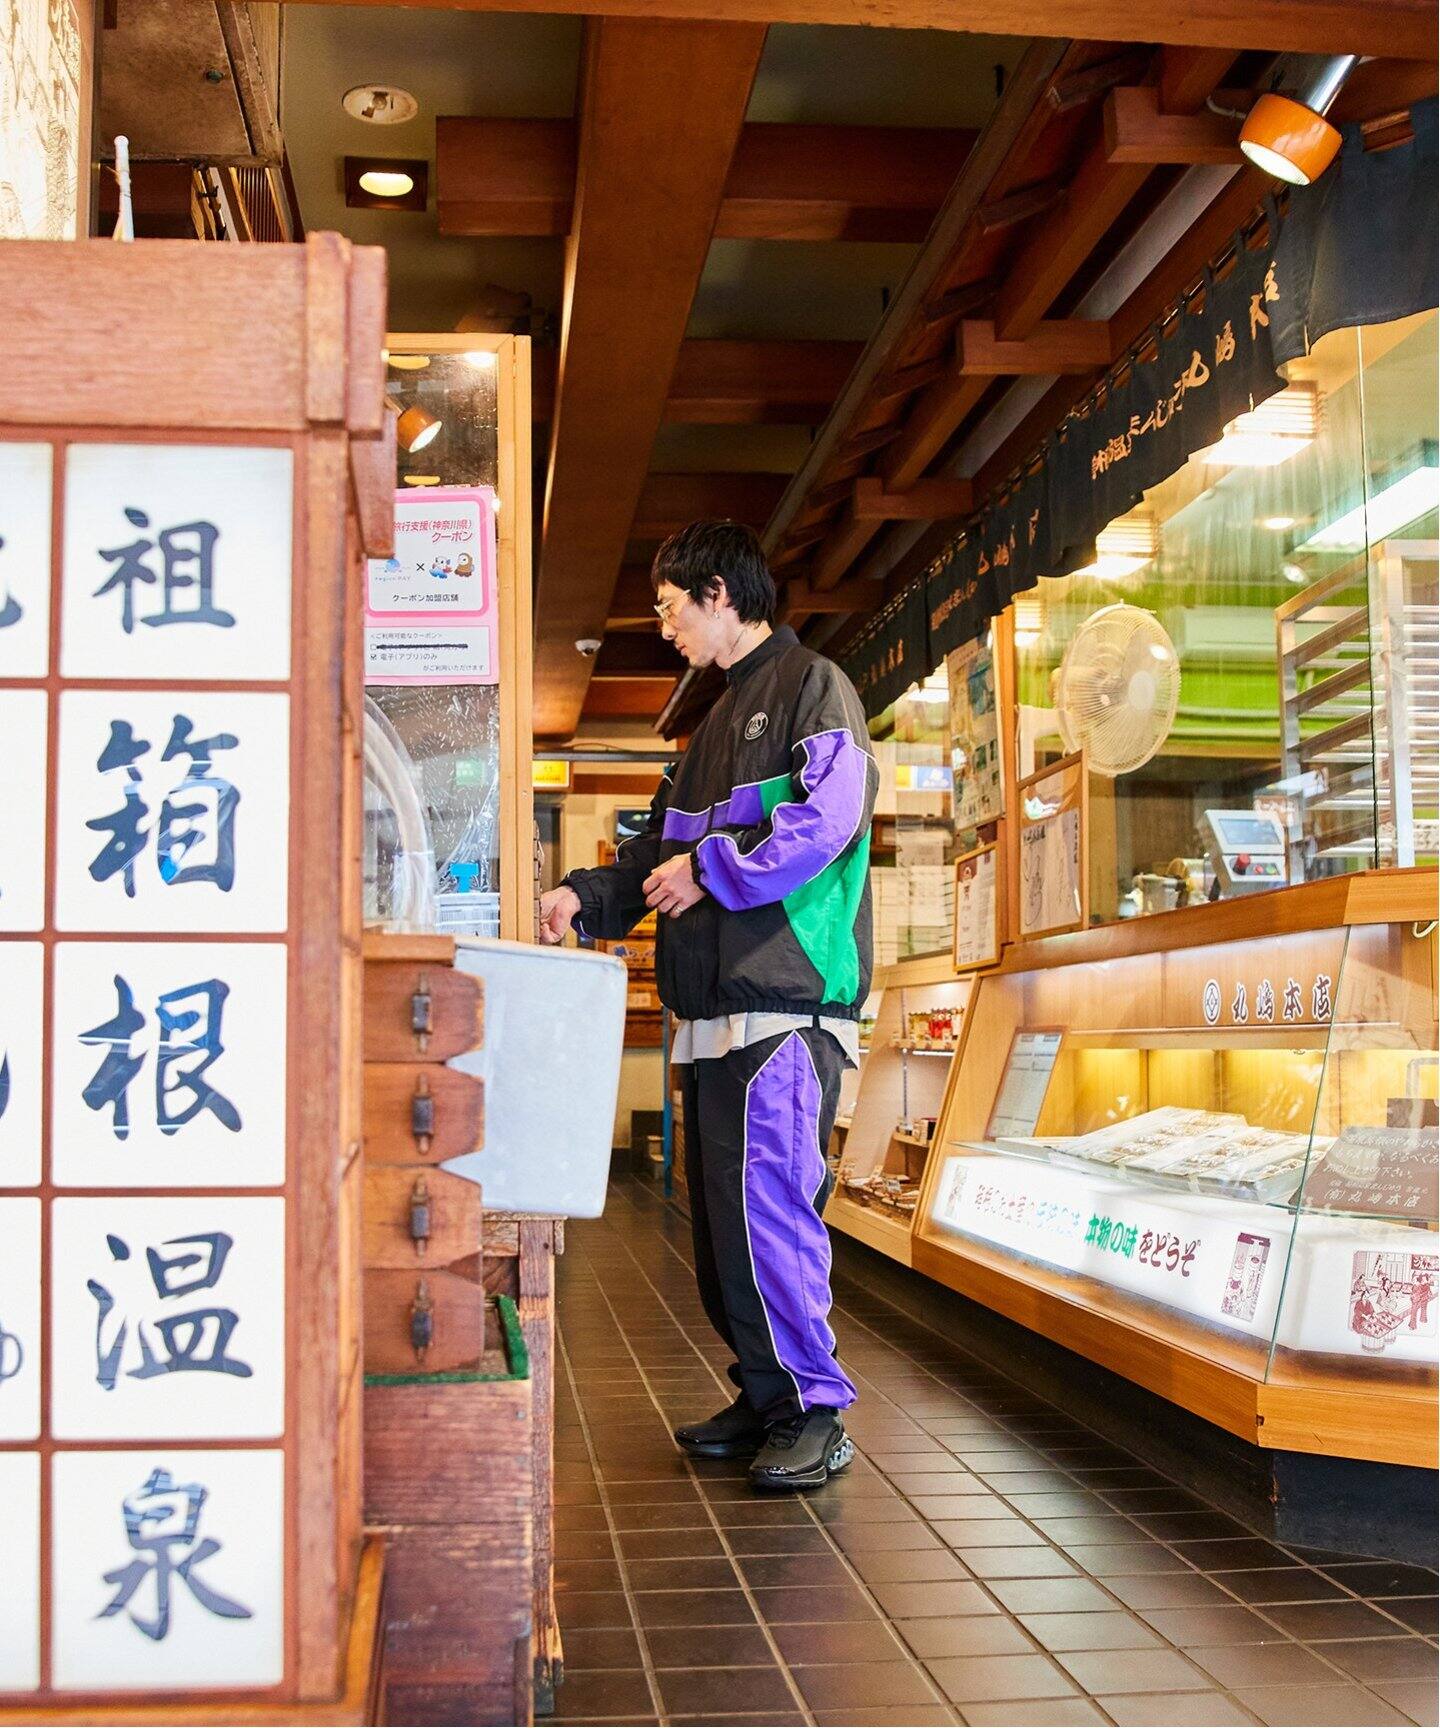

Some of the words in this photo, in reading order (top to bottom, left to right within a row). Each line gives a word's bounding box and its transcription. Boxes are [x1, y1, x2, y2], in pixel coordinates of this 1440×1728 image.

[432, 531, 474, 543] クーポン
[392, 593, 460, 603] クーポン加盟店舗
